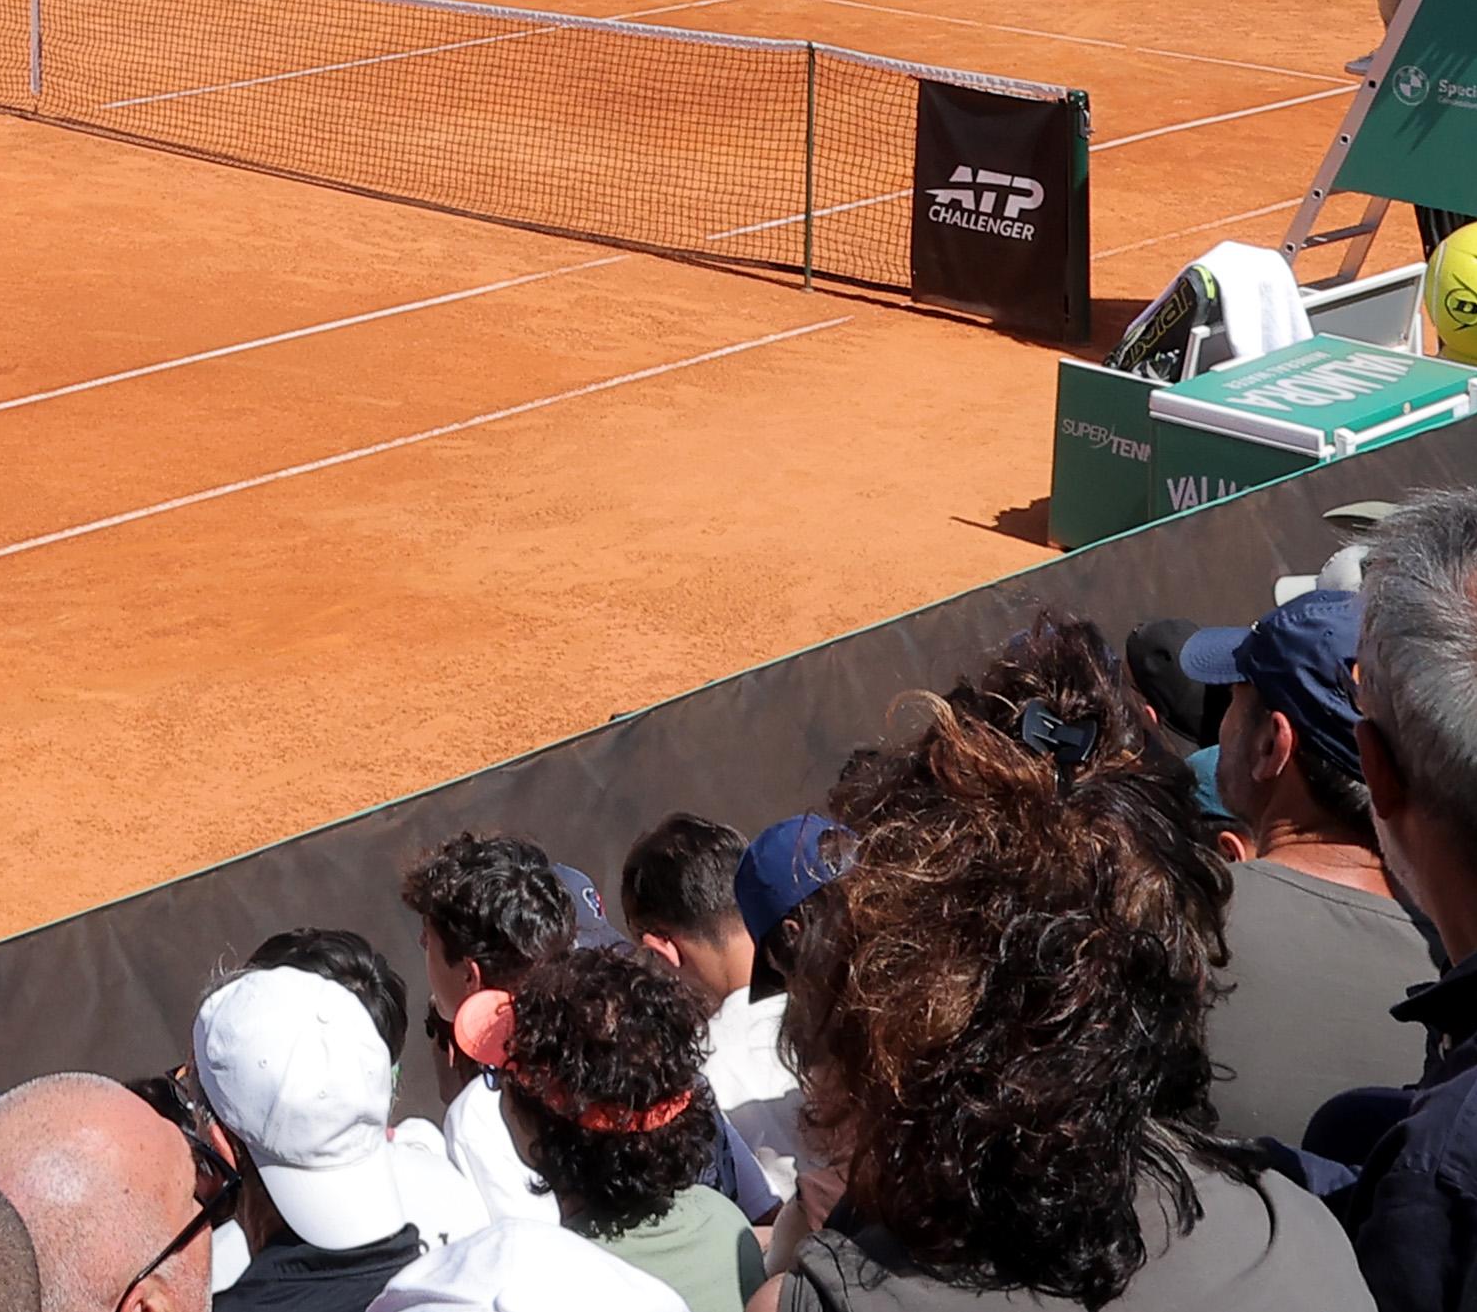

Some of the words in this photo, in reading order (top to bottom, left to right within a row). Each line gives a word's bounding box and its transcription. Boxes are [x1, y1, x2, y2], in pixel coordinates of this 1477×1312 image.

[926, 164, 1044, 219] ATP
[928, 203, 1035, 242] CHALLENGER
[1226, 352, 1415, 411] VALMORA
